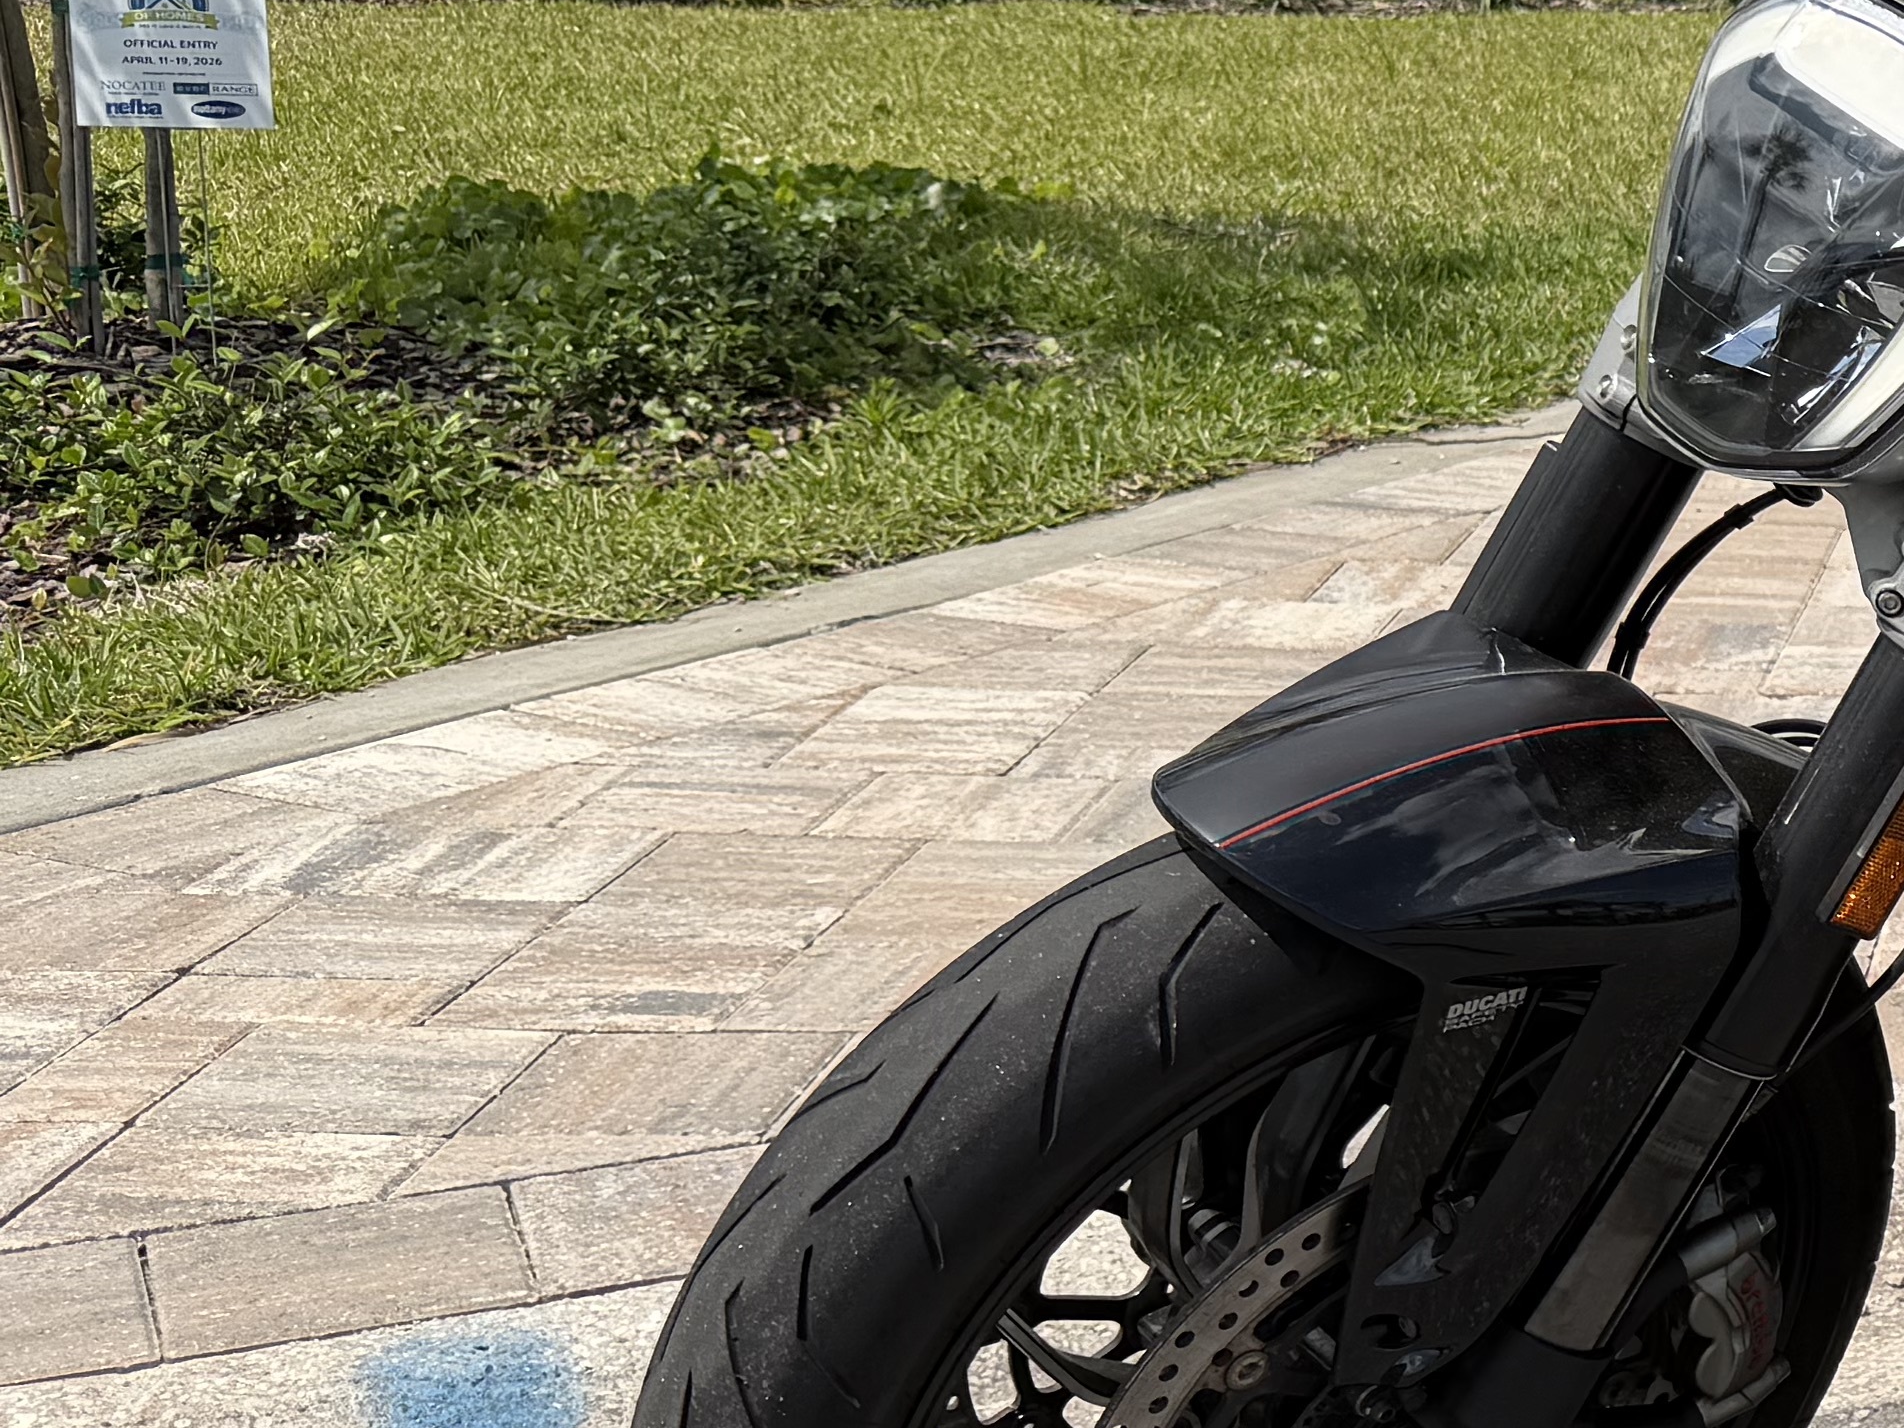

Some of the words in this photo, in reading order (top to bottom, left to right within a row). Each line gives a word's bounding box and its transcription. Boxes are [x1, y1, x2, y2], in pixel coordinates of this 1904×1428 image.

[155, 11, 205, 21] HOMES
[123, 39, 177, 49] OFFICIAL
[179, 39, 219, 50] ENTRY
[122, 56, 156, 65] APRIL
[193, 56, 223, 66] 2026
[105, 98, 162, 115] nefba
[1446, 985, 1528, 1019] DUCATI
